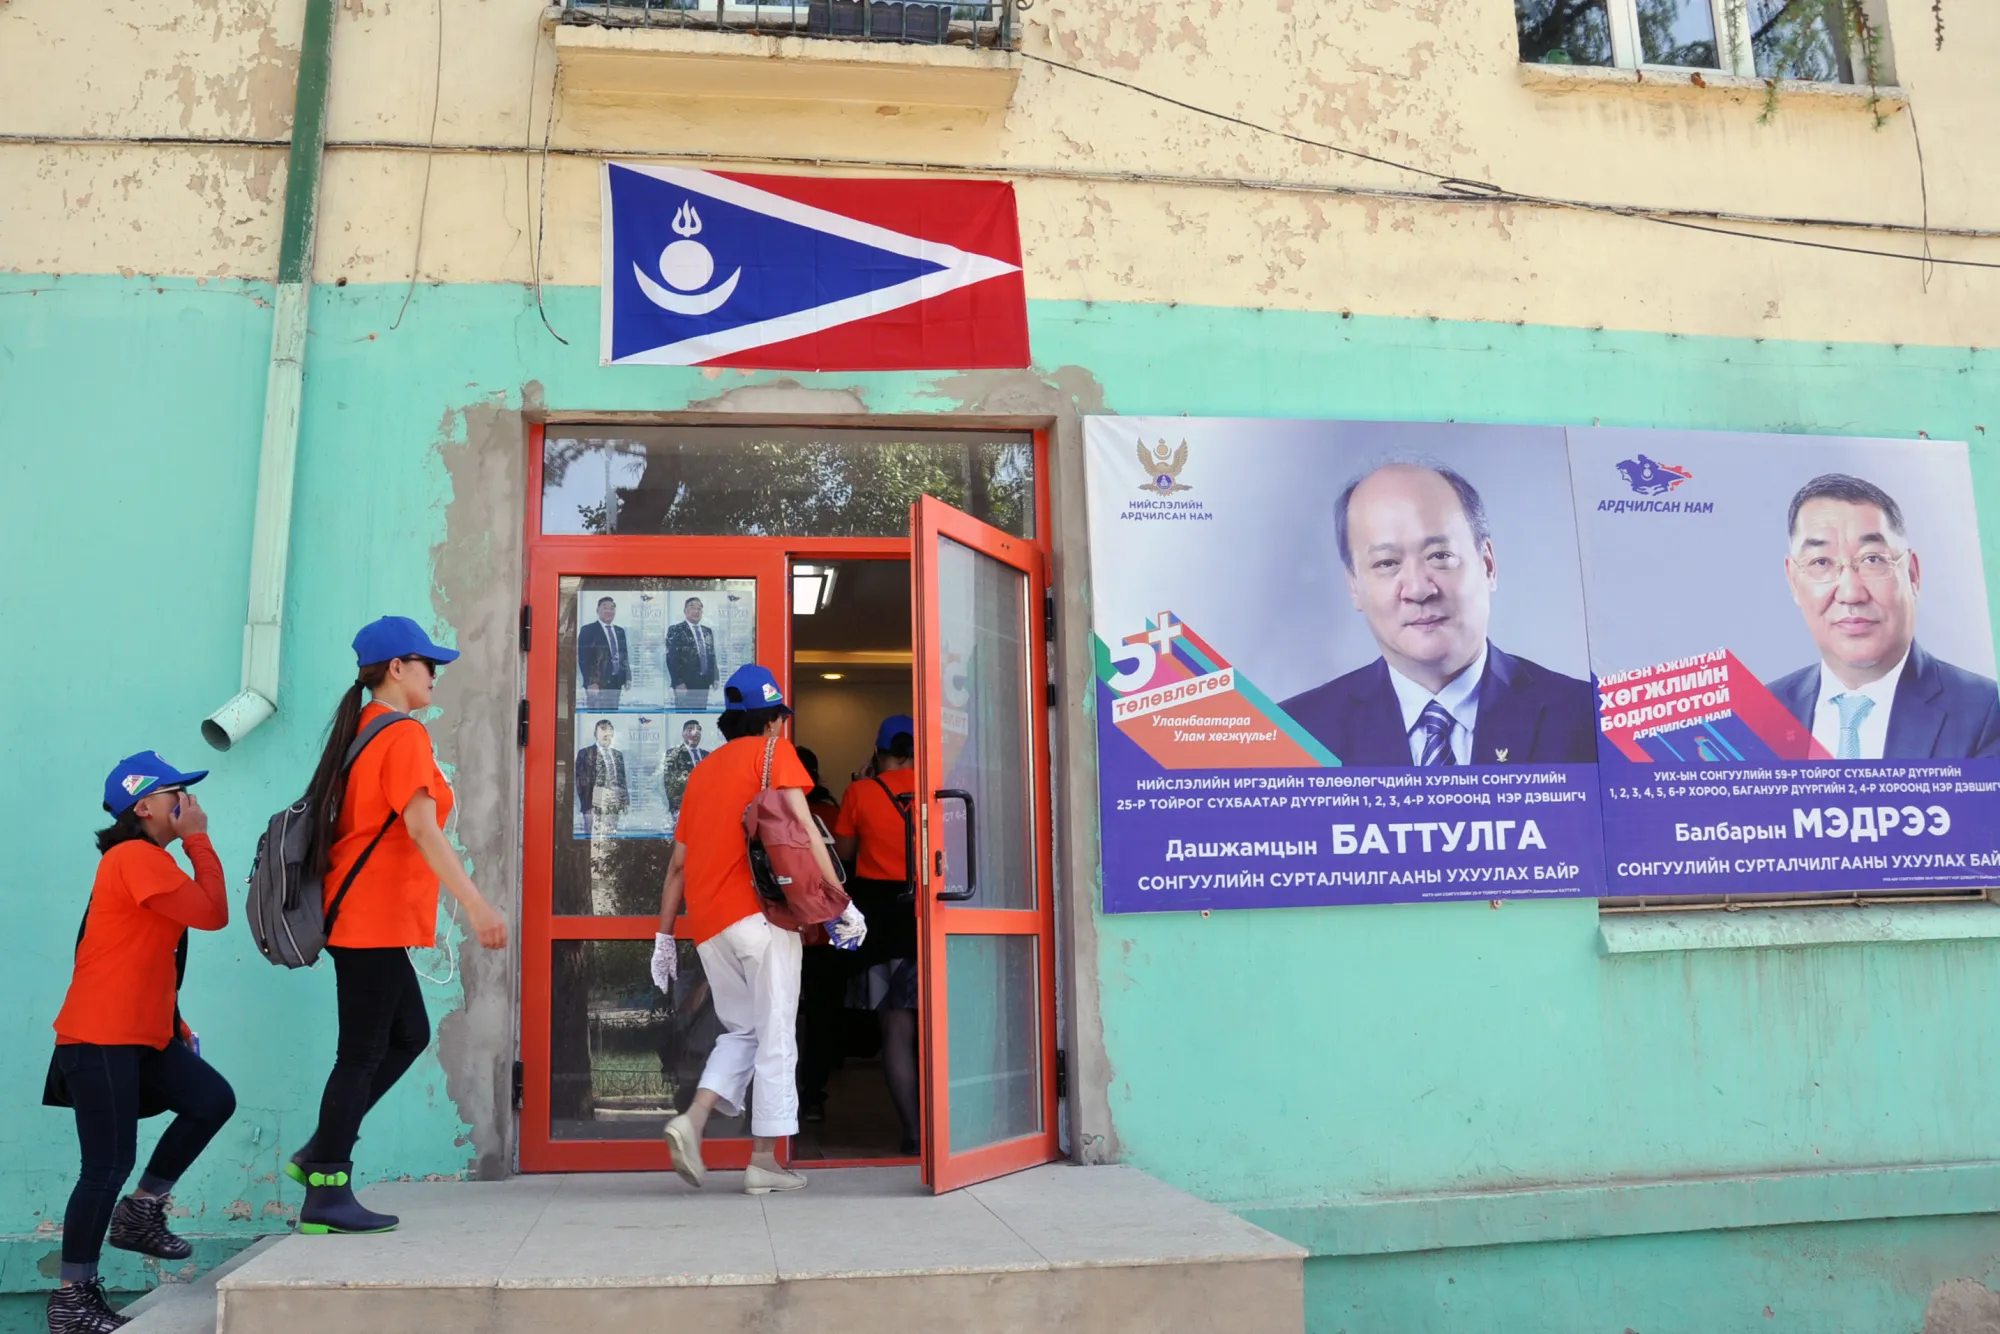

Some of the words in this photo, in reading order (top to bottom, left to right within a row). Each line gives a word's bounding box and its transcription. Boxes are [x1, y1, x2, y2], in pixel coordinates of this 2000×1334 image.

[1129, 500, 1203, 509] НИЙСЛЭЛИЙН
[1597, 500, 1680, 513] АРДЧИЛСАН
[1684, 502, 1714, 513] НАМ
[1121, 512, 1186, 521] АРДЧИЛСАН
[1597, 666, 1652, 688] ХИЙСЭН
[1656, 646, 1726, 675] АЖИЛТАЙ
[1598, 665, 1728, 711] ХӨГЖЛИЙН
[1600, 685, 1730, 732] БОДЛОГОТОЙ
[1152, 715, 1251, 728] Улаанбаатараа
[1633, 716, 1702, 740] АРДЧИЛСАН
[1705, 709, 1732, 722] НАМ
[1174, 731, 1205, 742] Улам
[1209, 730, 1276, 743] хөгжүүлье!
[1137, 776, 1230, 790] НИЙСЛЭЛИЙН
[1234, 775, 1304, 789] ИРГЭДИЙН
[1308, 774, 1421, 788] ТӨЛӨӨЛӨГЧДИЙН
[1426, 775, 1478, 785] ХУРЛЫН
[1482, 771, 1566, 784] СОНГУУЛИЙН
[1654, 771, 1697, 781] УИХ-ЫН
[1700, 768, 1772, 780] СОНГУУЛИЙН
[1775, 770, 1797, 779] 59-Р
[1800, 767, 1841, 778] ТОЙРОГ
[1845, 768, 1906, 778] СҮХБААТАР
[1908, 766, 1961, 778] ДҮҮРГИЙН
[1610, 788, 1617, 799] 1,
[1620, 788, 1629, 799] 2,
[1632, 788, 1641, 799] 3,
[1644, 788, 1654, 798] 4,
[1657, 787, 1666, 798] 5,
[1669, 787, 1686, 796] 6-Р
[1689, 786, 1730, 797] ХОРОО,
[1733, 785, 1788, 795] БАГАНУУР
[1791, 782, 1845, 795] ДҮҮРГИЙН
[1849, 784, 1857, 794] 2,
[1860, 784, 1876, 792] 4-Р
[1879, 783, 1930, 793] ХОРООНД
[1932, 783, 1952, 792] НЭР
[1117, 800, 1145, 810] 25-Р
[1149, 796, 1203, 809] ТОЙРОГ
[1208, 797, 1287, 808] СҮХБААТАР
[1291, 794, 1359, 808] ДҮҮРГИЙН
[1363, 796, 1371, 807] 1,
[1375, 796, 1385, 807] 2,
[1390, 796, 1400, 807] 3,
[1404, 795, 1424, 805] 4-Р
[1428, 794, 1490, 805] ХОРООНД
[1497, 793, 1521, 803] НЭР
[1525, 792, 1585, 804] ДЭВШИГЧ
[1675, 822, 1786, 843] Балбарын
[1793, 806, 1950, 842] МЭДРЭЭ
[1166, 840, 1317, 861] Дашжамцын
[1332, 820, 1547, 854] БАТТУЛГА
[1617, 857, 1729, 876] СОНГУУЛИЙН
[1735, 856, 1887, 872] СУРТАЛЧИЛГААНЫ
[1892, 854, 1965, 868] УХУУЛАХ
[1138, 870, 1264, 890] СОНГУУЛИЙН
[1270, 870, 1441, 886] СУРТАЛЧИЛГААНЫ
[1447, 867, 1529, 882] УХУУЛАХ
[1534, 862, 1579, 879] БАЙР
